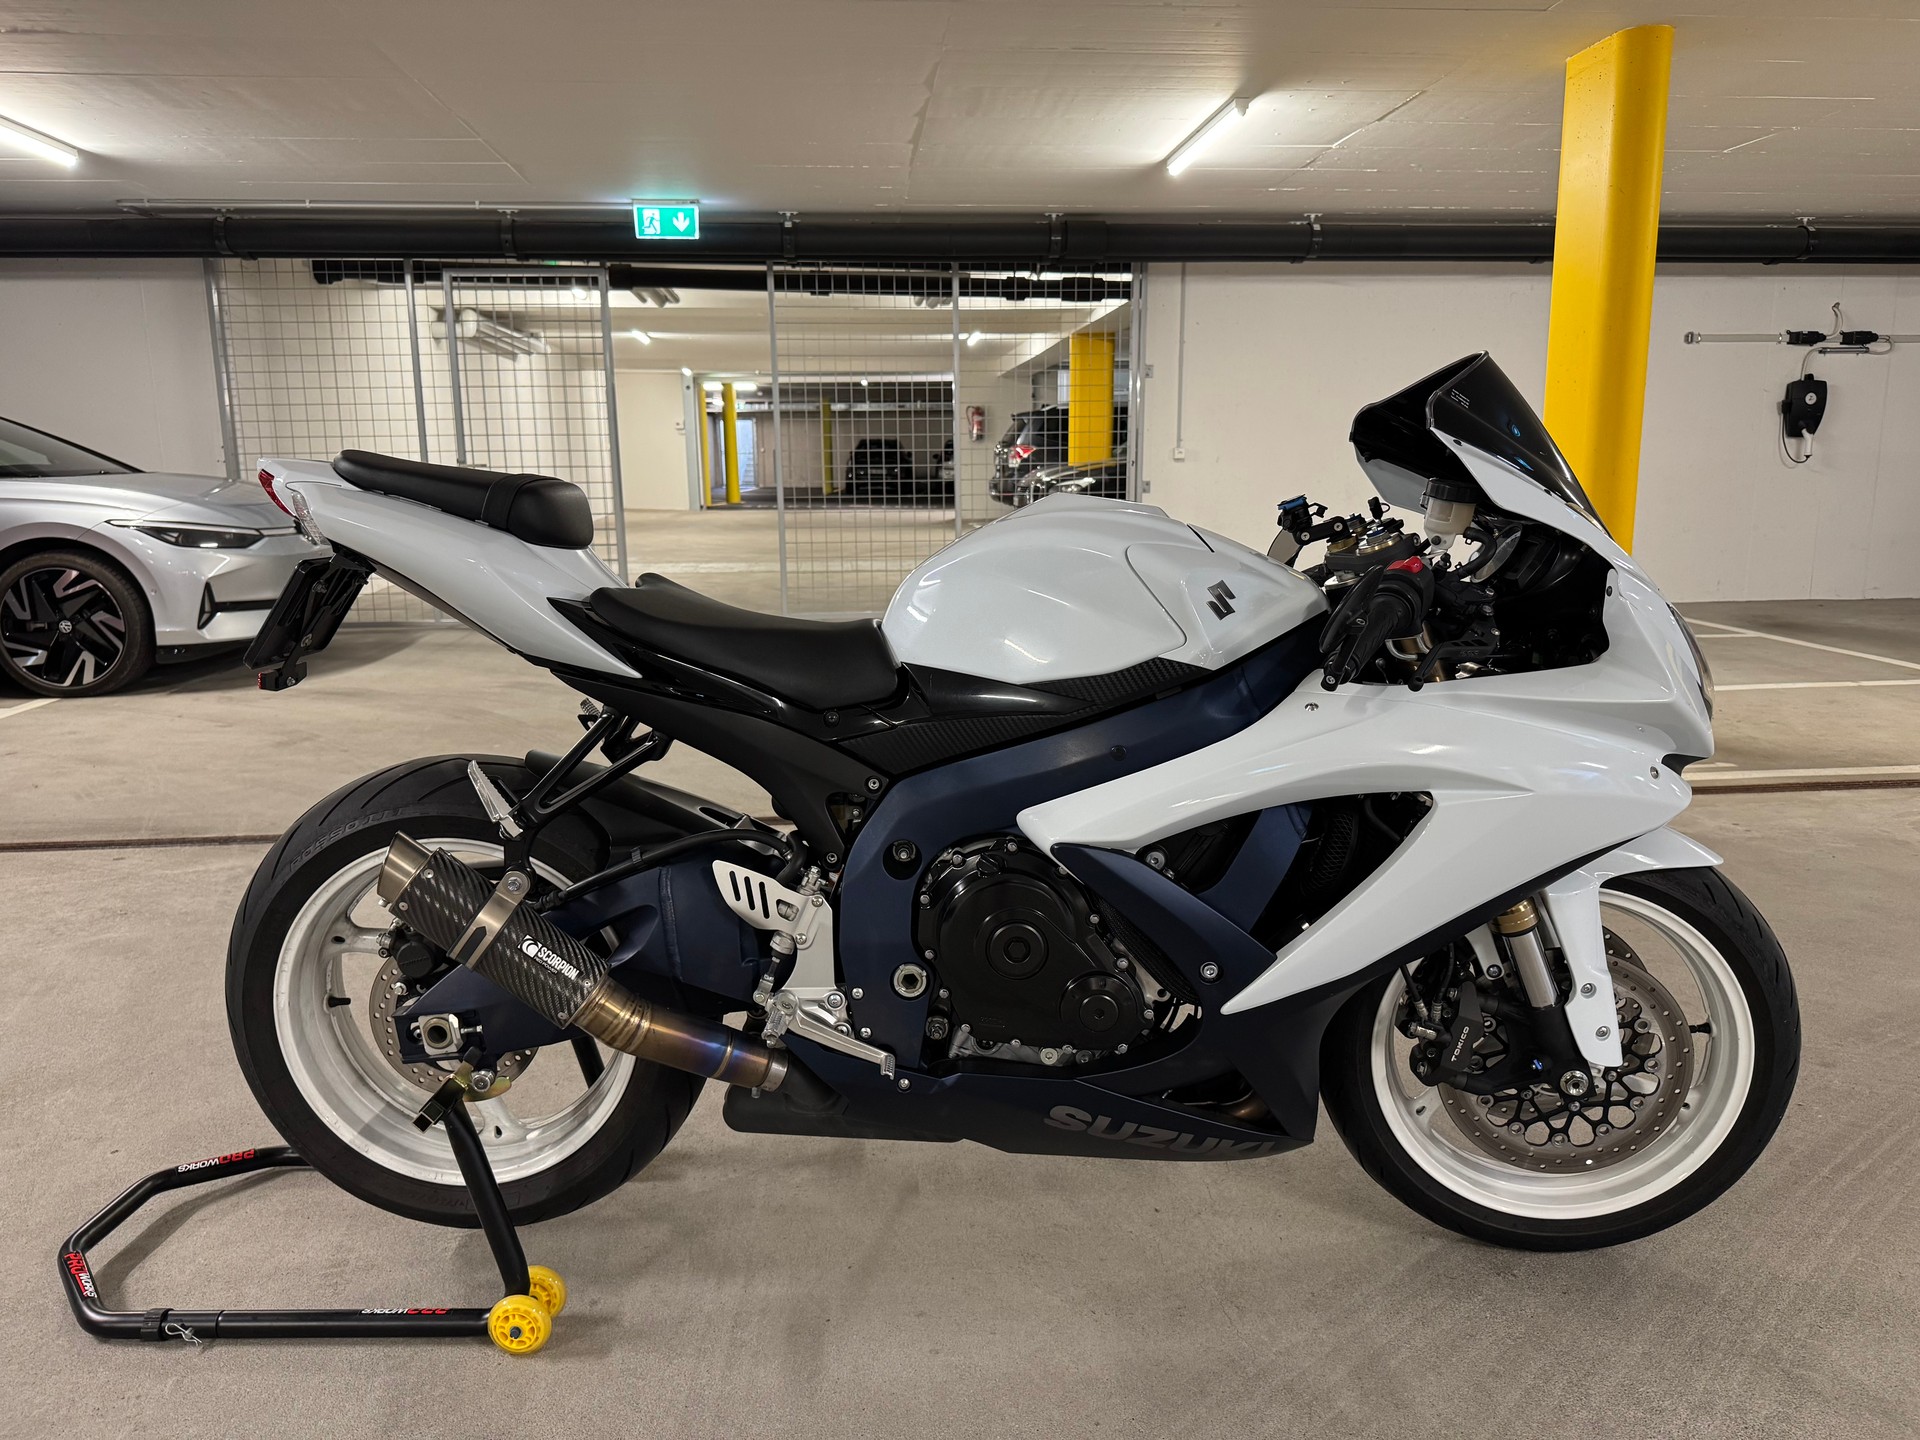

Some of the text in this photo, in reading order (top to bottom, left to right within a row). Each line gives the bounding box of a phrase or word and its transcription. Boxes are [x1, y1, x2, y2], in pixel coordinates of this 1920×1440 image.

[537, 947, 580, 981] SCORPION
[1451, 1026, 1470, 1062] TOKICO
[1044, 1105, 1278, 1158] SUZUKI
